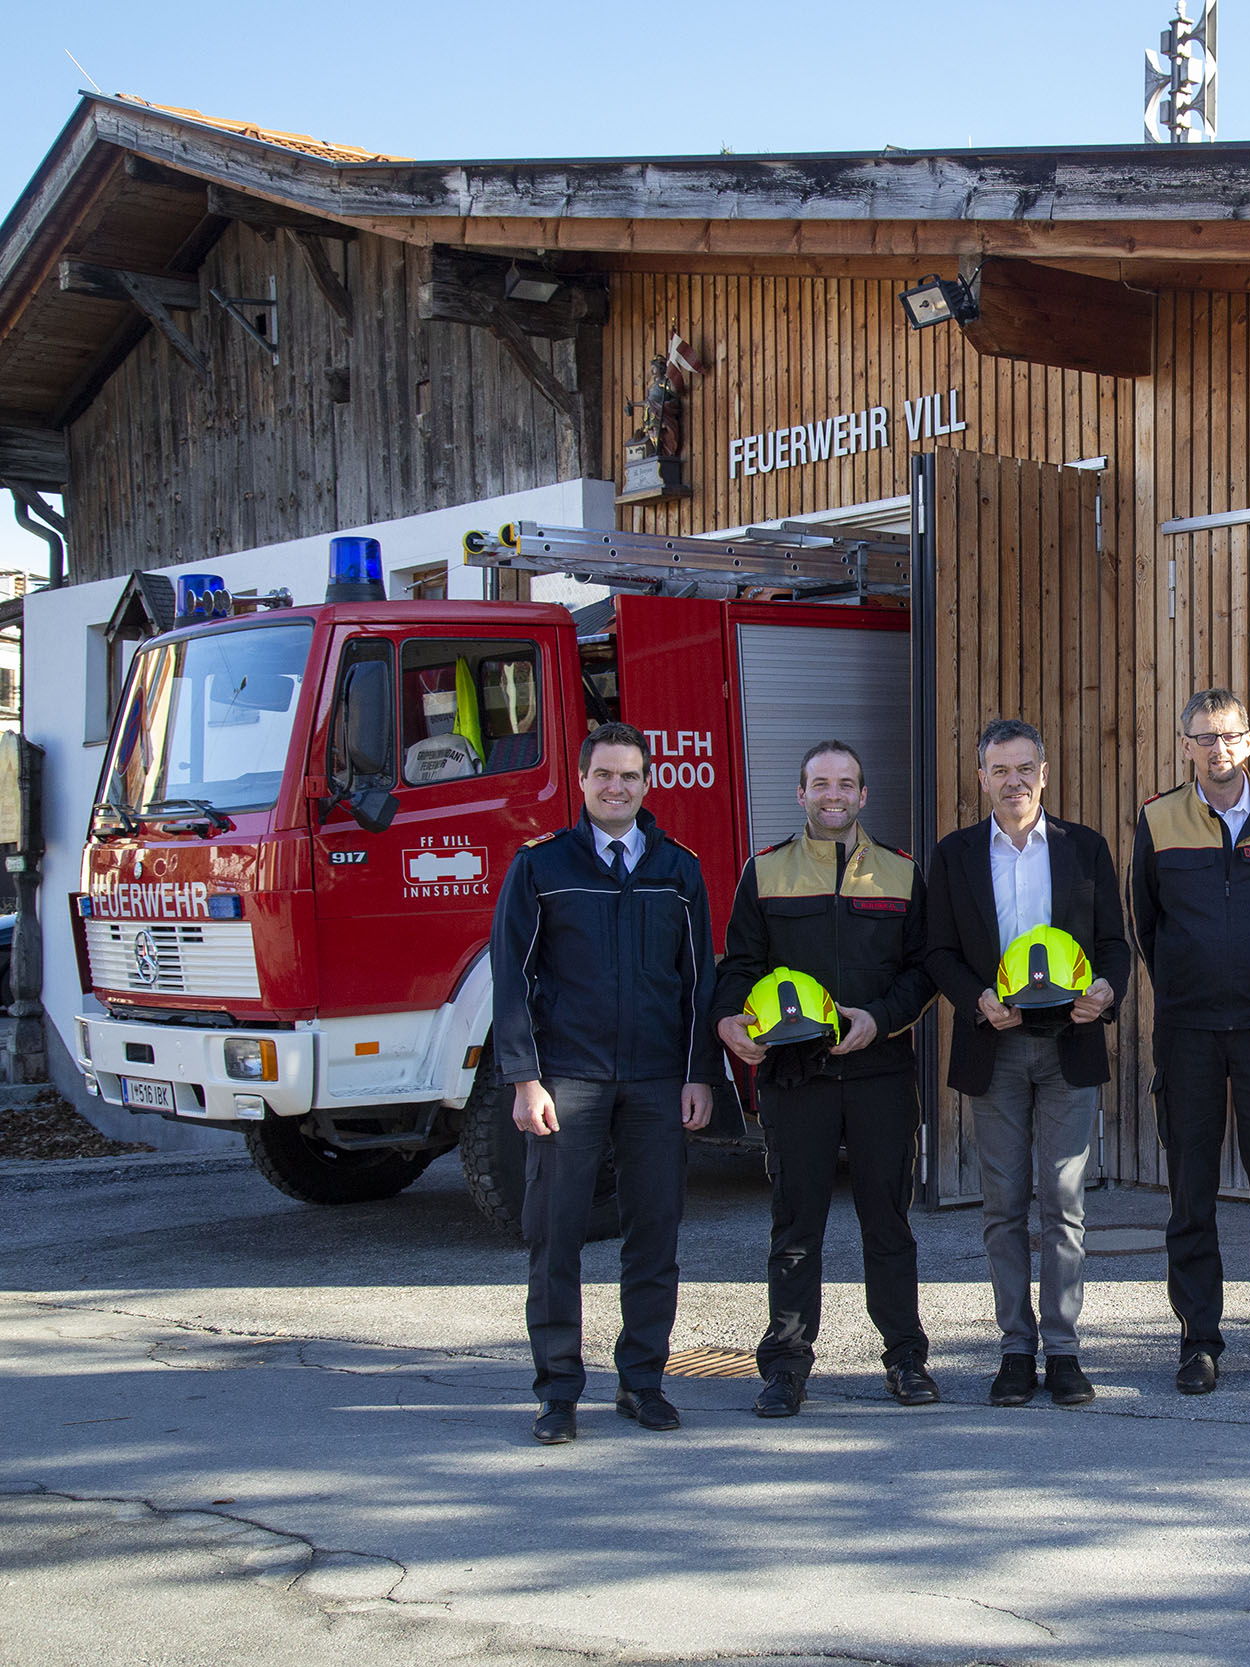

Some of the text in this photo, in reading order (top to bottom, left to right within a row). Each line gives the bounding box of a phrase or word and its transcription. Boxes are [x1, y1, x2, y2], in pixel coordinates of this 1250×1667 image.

[729, 389, 967, 479] FEUERWEHR VILL
[643, 730, 713, 757] TLFH
[649, 762, 715, 789] 1000
[420, 835, 471, 847] FF VILL
[331, 851, 366, 864] 917
[92, 881, 210, 918] FEUERWEHR
[403, 883, 489, 899] INNSBRUCK
